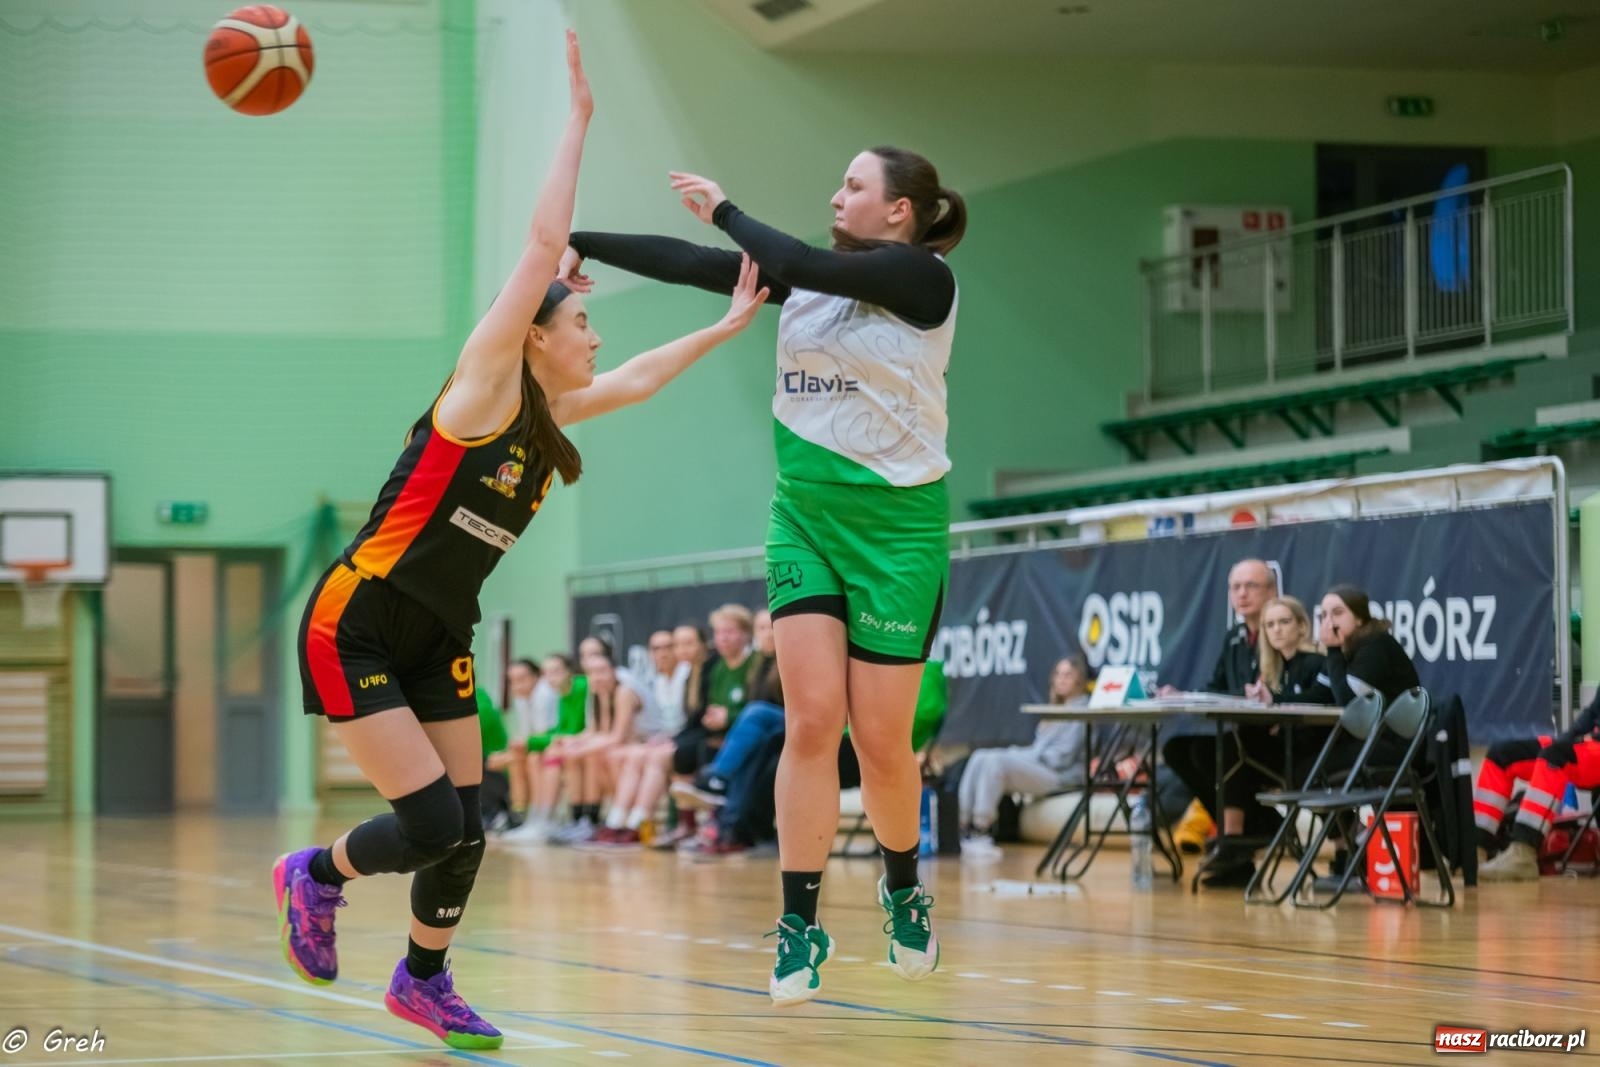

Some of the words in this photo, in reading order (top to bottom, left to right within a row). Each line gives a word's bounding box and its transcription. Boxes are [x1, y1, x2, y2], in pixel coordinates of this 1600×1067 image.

[930, 607, 1028, 677] CIBÓRZ
[451, 656, 474, 698] 9
[445, 906, 462, 918] NB
